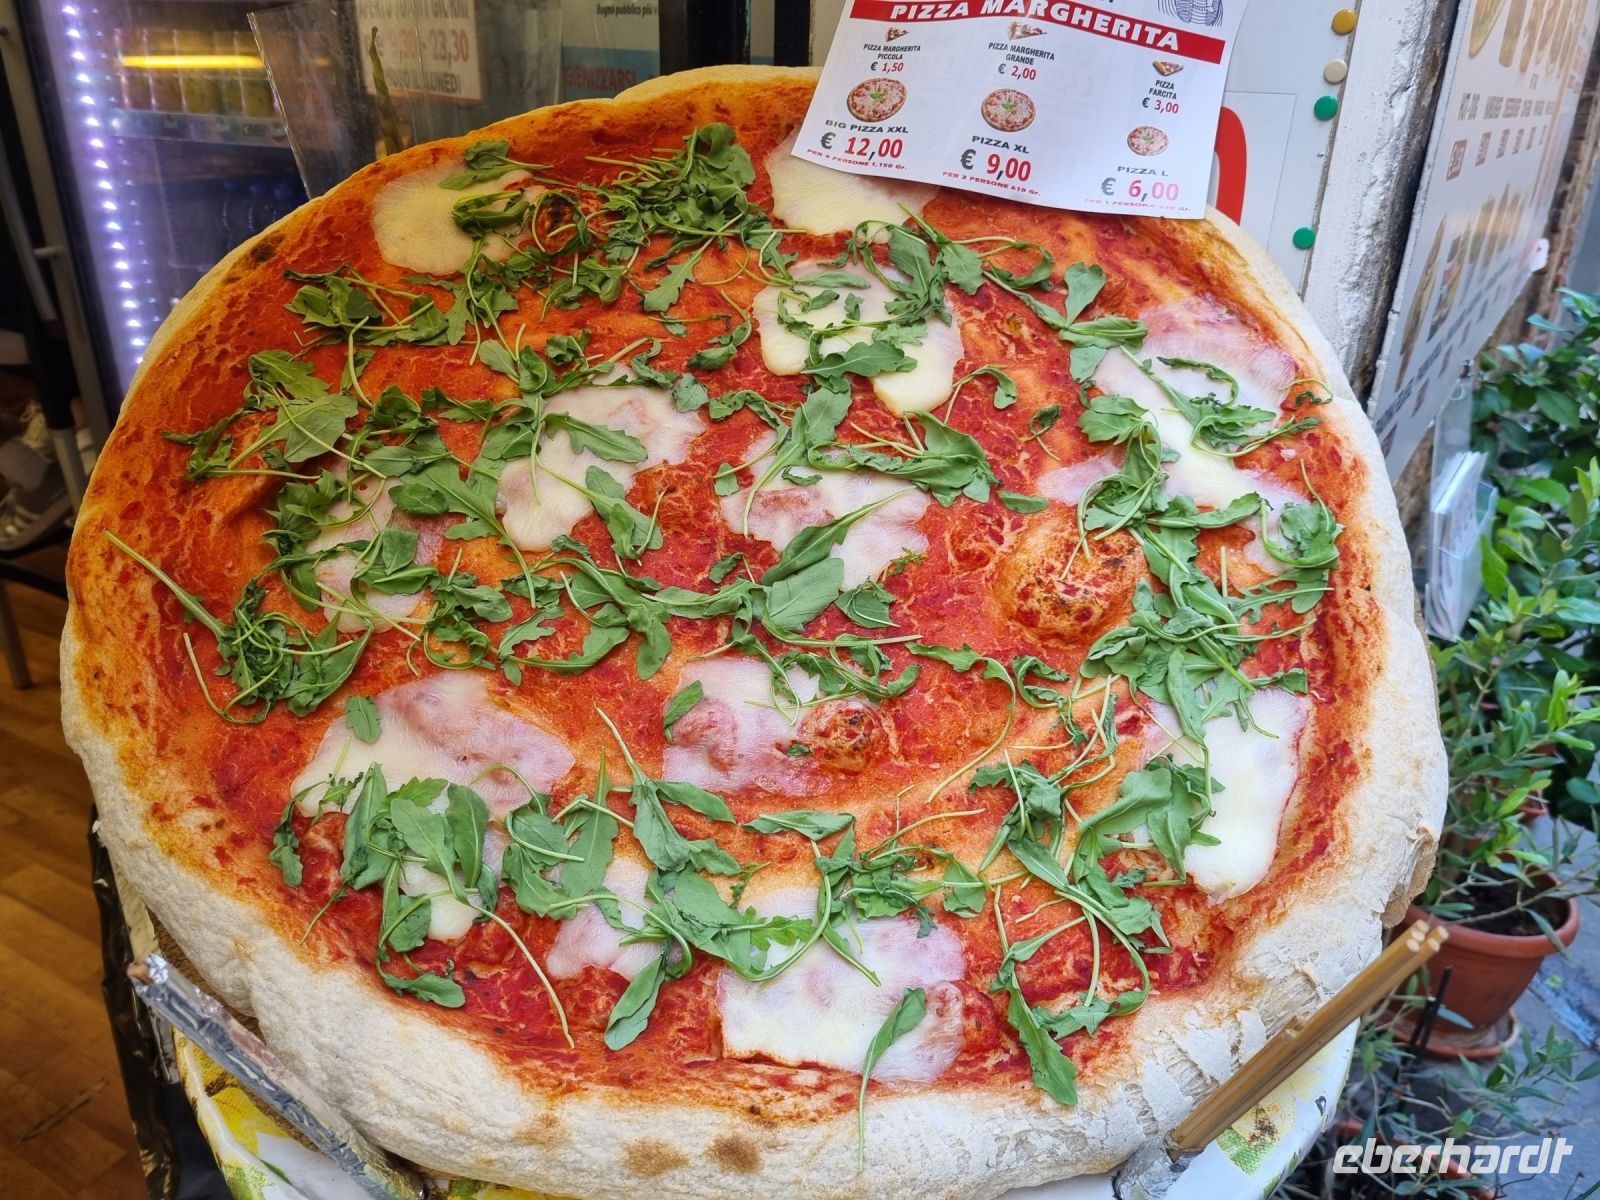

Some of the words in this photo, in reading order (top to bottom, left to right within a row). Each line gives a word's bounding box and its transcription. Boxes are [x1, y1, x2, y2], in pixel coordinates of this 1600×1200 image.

[616, 4, 641, 17] pubblico
[890, 2, 969, 20] PIZZA
[980, 0, 1179, 51] MARGHERITA
[428, 28, 469, 68] 23,30
[863, 43, 882, 51] PIZZA
[883, 44, 921, 52] MARGHERITA
[987, 42, 1008, 51] PIZZA
[1009, 43, 1055, 61] MARGHERITA
[870, 62, 878, 72] €
[881, 61, 905, 75] 1,50
[1005, 53, 1034, 66] GRANDE
[997, 63, 1006, 75] €
[1011, 65, 1037, 81] 2,00
[1148, 87, 1177, 100] FARCITA
[1155, 79, 1175, 90] PIZZA
[1141, 97, 1150, 108] €
[1153, 99, 1179, 114] 3,00
[825, 119, 847, 129] BIG
[850, 123, 884, 133] PIZZA
[886, 125, 909, 134] XXL
[819, 131, 836, 150] €
[844, 136, 904, 161] 12,00
[971, 135, 1010, 149] PIZZA
[1013, 144, 1030, 154] XL
[806, 148, 823, 157] PER
[832, 155, 870, 168] PERSONE
[960, 148, 977, 171] €
[986, 153, 1031, 182] 9,00
[1117, 166, 1157, 176] PIZZA
[942, 171, 959, 179] PER
[969, 176, 1009, 190] PERSONE
[1100, 177, 1116, 196] €
[1128, 179, 1179, 202] 6,00
